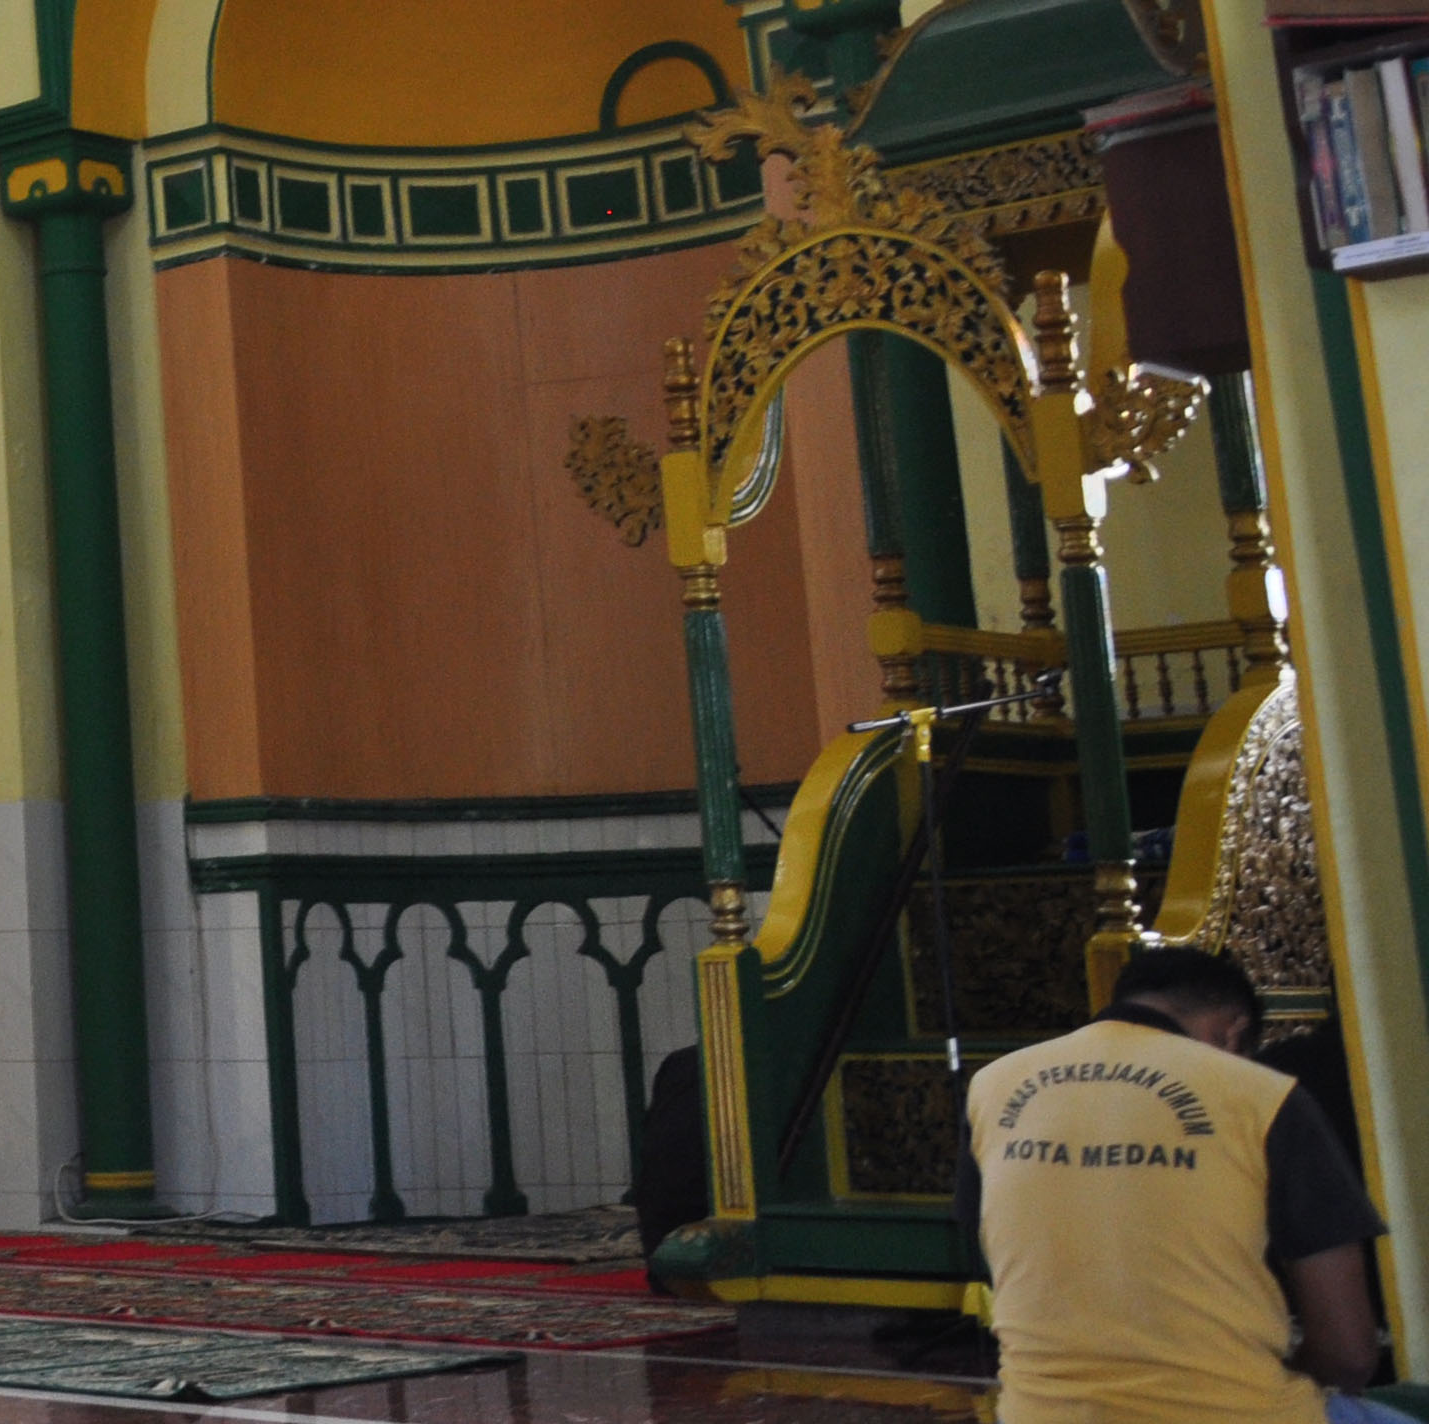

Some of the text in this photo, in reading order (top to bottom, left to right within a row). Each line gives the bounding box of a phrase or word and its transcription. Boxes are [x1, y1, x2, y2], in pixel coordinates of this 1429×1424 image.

[998, 1062, 1215, 1137] DINAS PEKERJAAN UMUM
[1003, 1139, 1197, 1170] KOTA MEDAN
